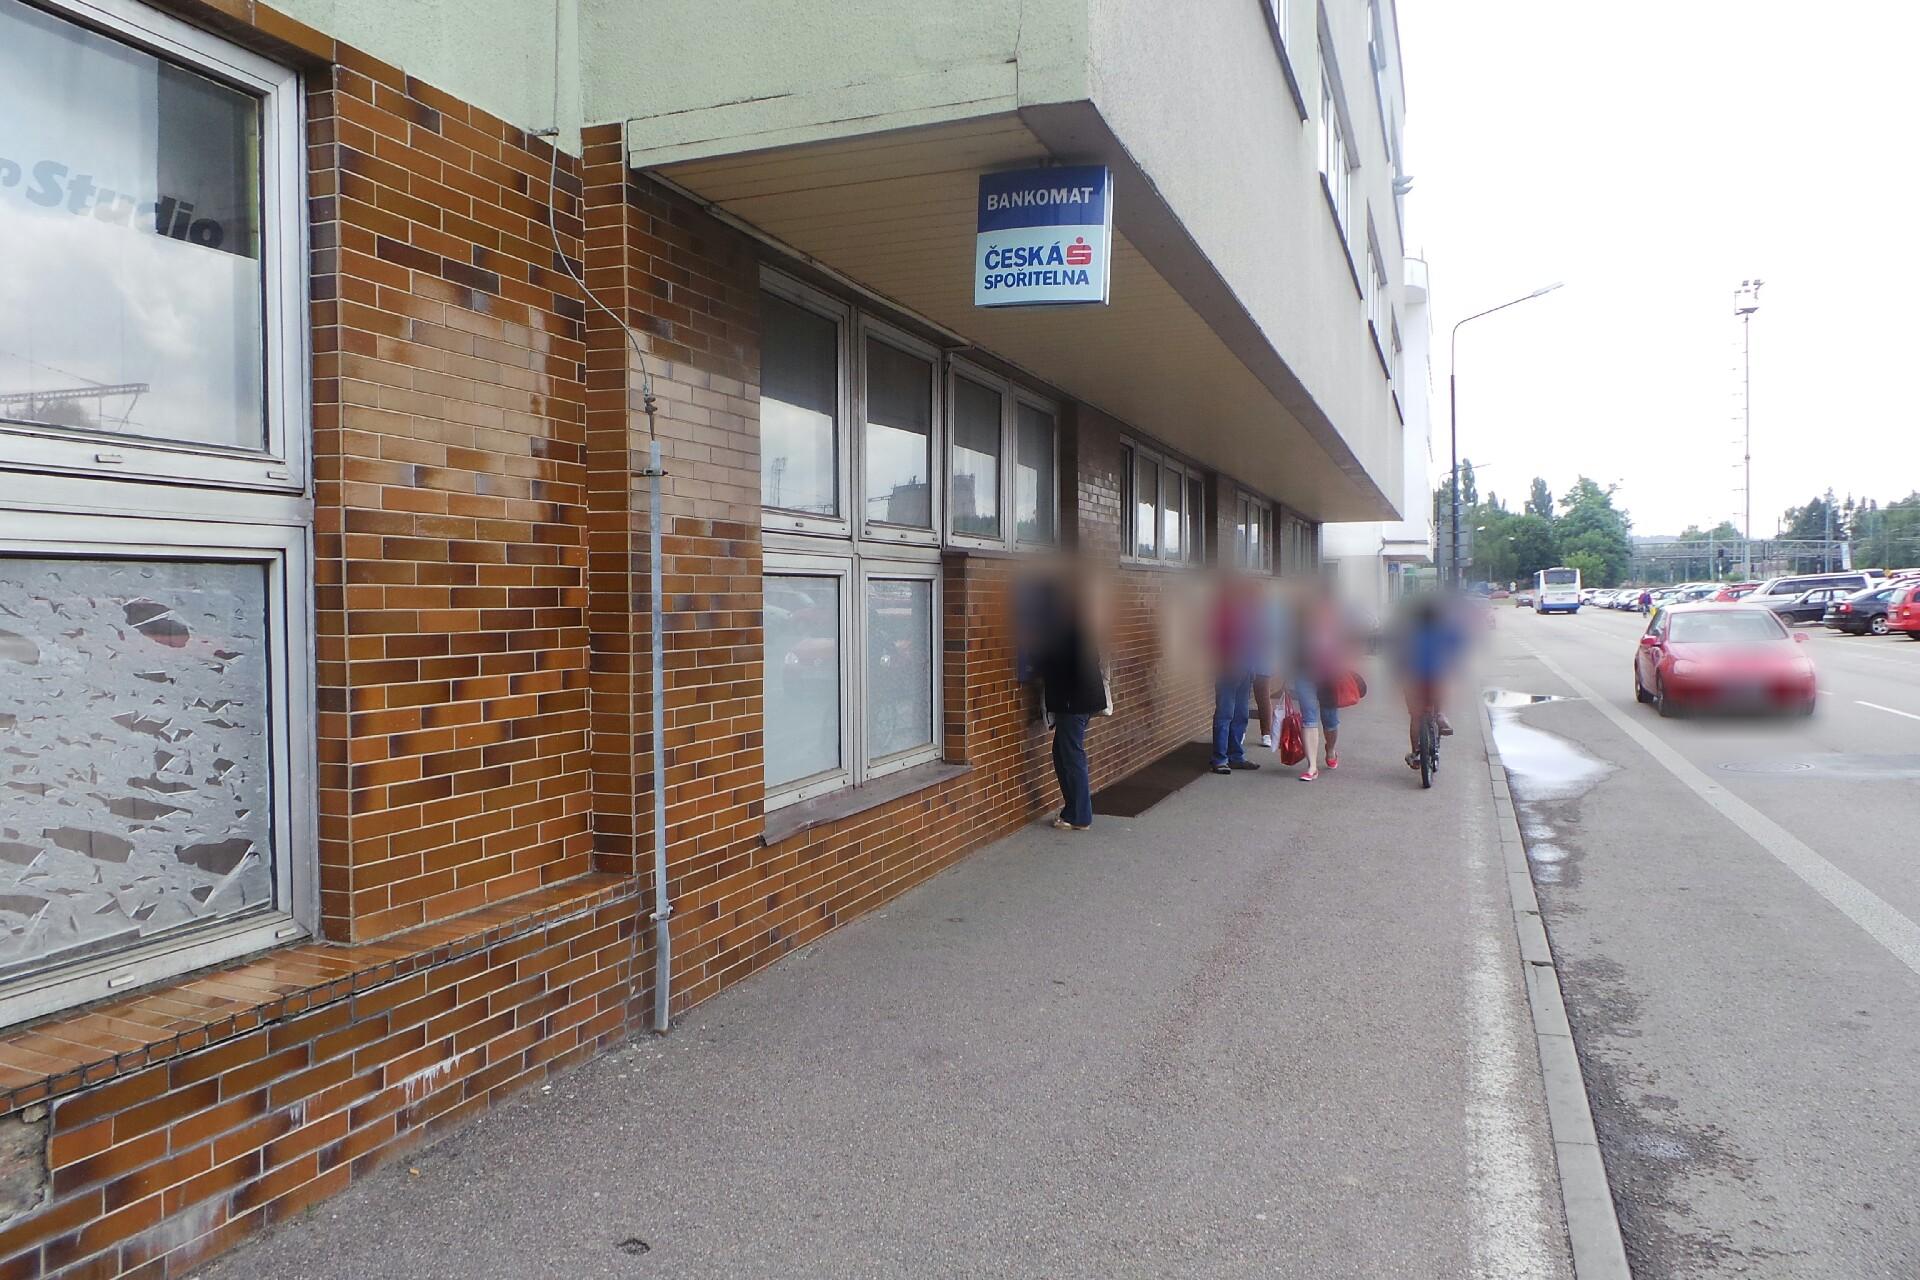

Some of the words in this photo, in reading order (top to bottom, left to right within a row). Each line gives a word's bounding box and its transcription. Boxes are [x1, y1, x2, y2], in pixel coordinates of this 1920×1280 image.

[987, 187, 1093, 211] BANKOMAT
[984, 241, 1064, 270] ČESKÁ
[984, 268, 1090, 290] SPOŘITELNA
